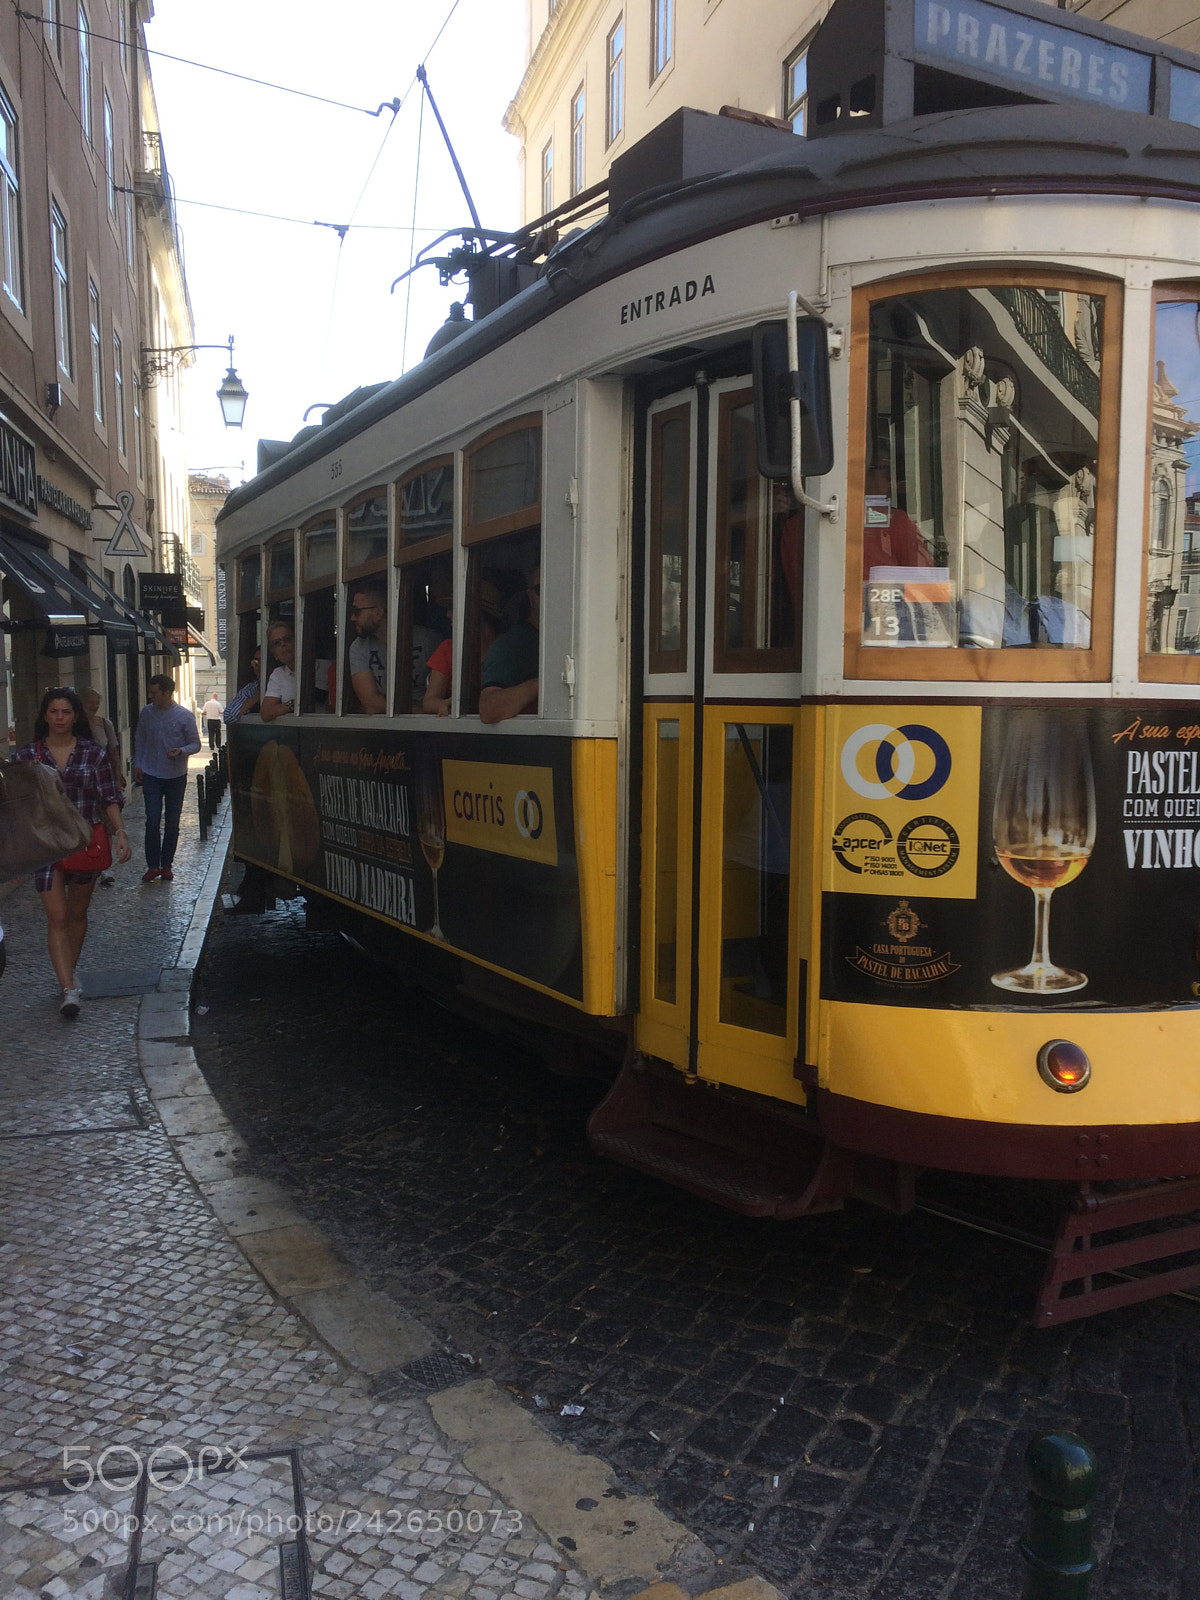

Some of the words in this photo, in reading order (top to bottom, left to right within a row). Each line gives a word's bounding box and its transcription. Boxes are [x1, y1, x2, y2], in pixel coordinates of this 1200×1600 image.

[926, 1, 1129, 103] PRAZERES
[620, 274, 715, 325] ENTRADA
[0, 426, 38, 514] INHA
[330, 459, 343, 480] 555
[870, 589, 901, 602] 28E
[871, 616, 900, 636] 13
[1139, 725, 1171, 739] sua
[1126, 750, 1200, 794] PASTEL
[319, 773, 348, 821] PASTEL
[346, 778, 361, 824] DE
[360, 780, 410, 837] BACALHAU
[453, 781, 505, 827] carris
[1123, 799, 1159, 817] COM
[842, 838, 882, 852] apcer
[908, 841, 947, 853] IQNet
[324, 850, 357, 901] VINHO
[360, 862, 416, 926] MADEIRA
[873, 943, 889, 954] CASA
[857, 955, 887, 977] PASTEL
[890, 966, 903, 979] DE
